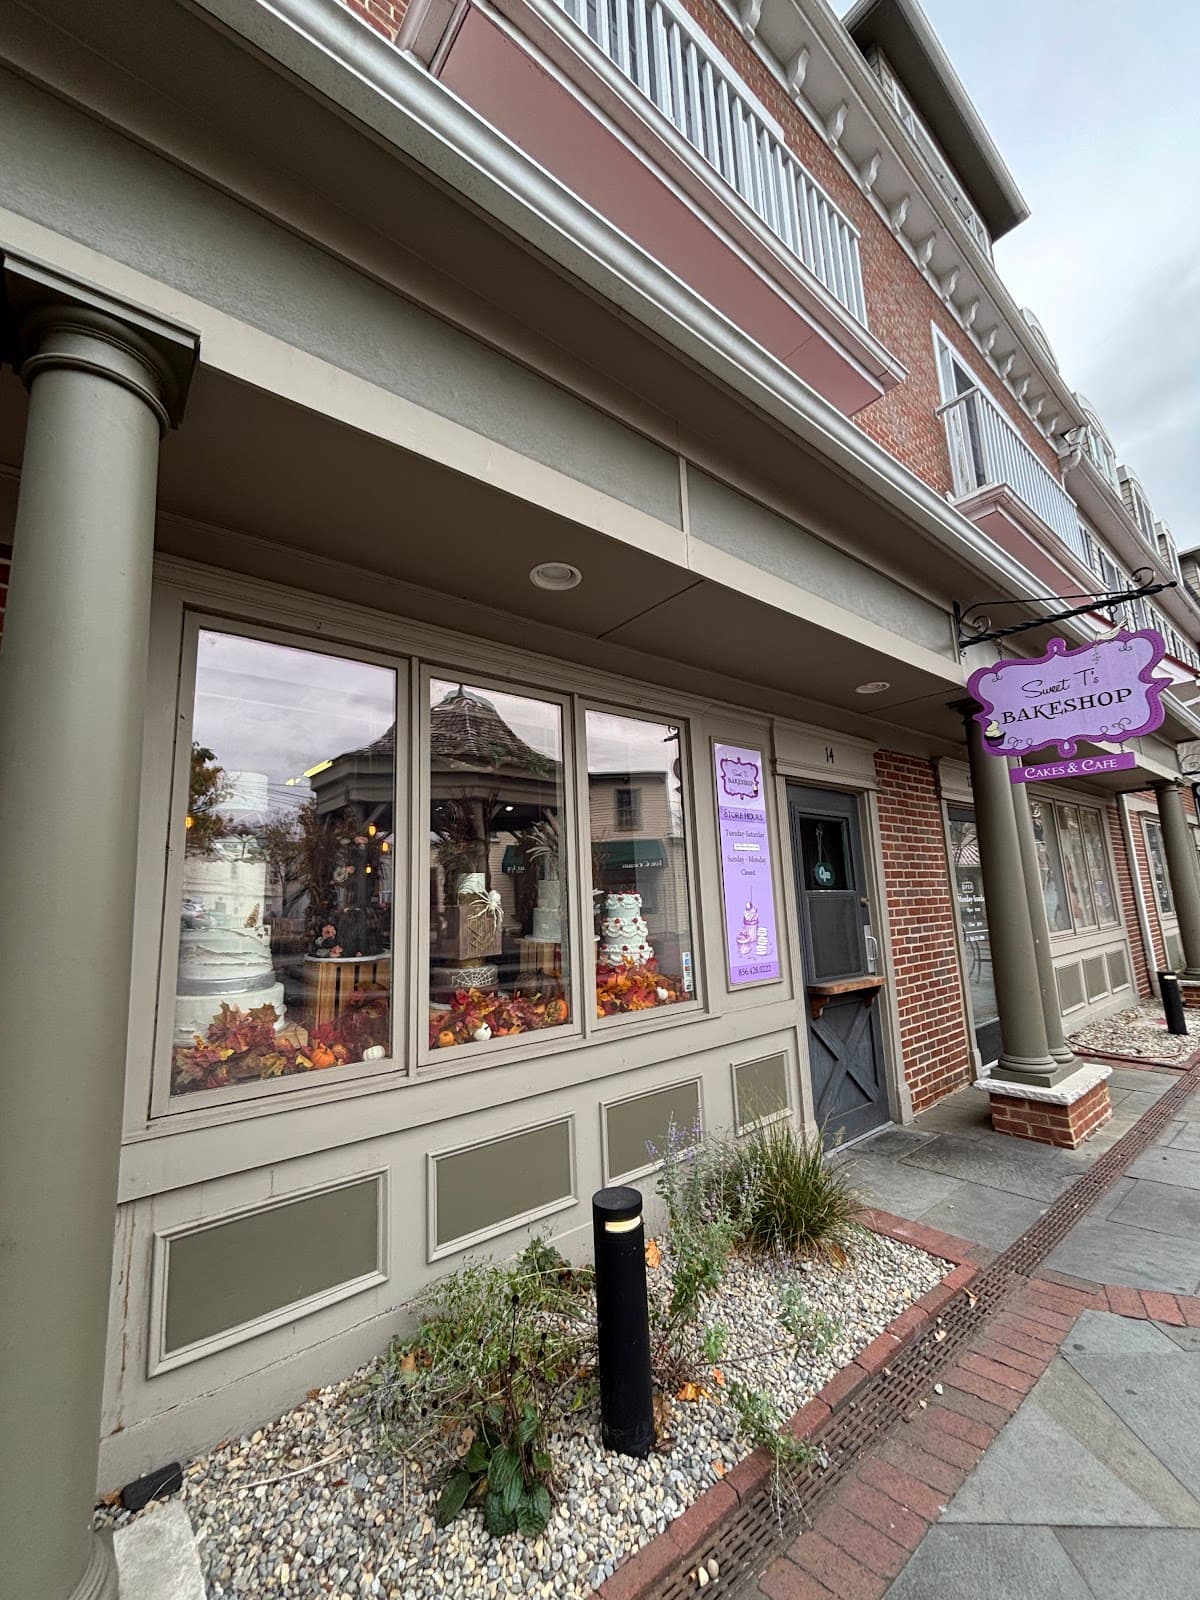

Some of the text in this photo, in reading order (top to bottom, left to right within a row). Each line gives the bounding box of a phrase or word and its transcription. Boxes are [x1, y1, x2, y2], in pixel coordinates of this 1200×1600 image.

[1021, 667, 1100, 699] Sweet T's
[1001, 688, 1132, 725] BAKESHOP
[825, 746, 835, 764] 14
[1067, 762, 1079, 773] &
[723, 808, 763, 821] STORE HOURS
